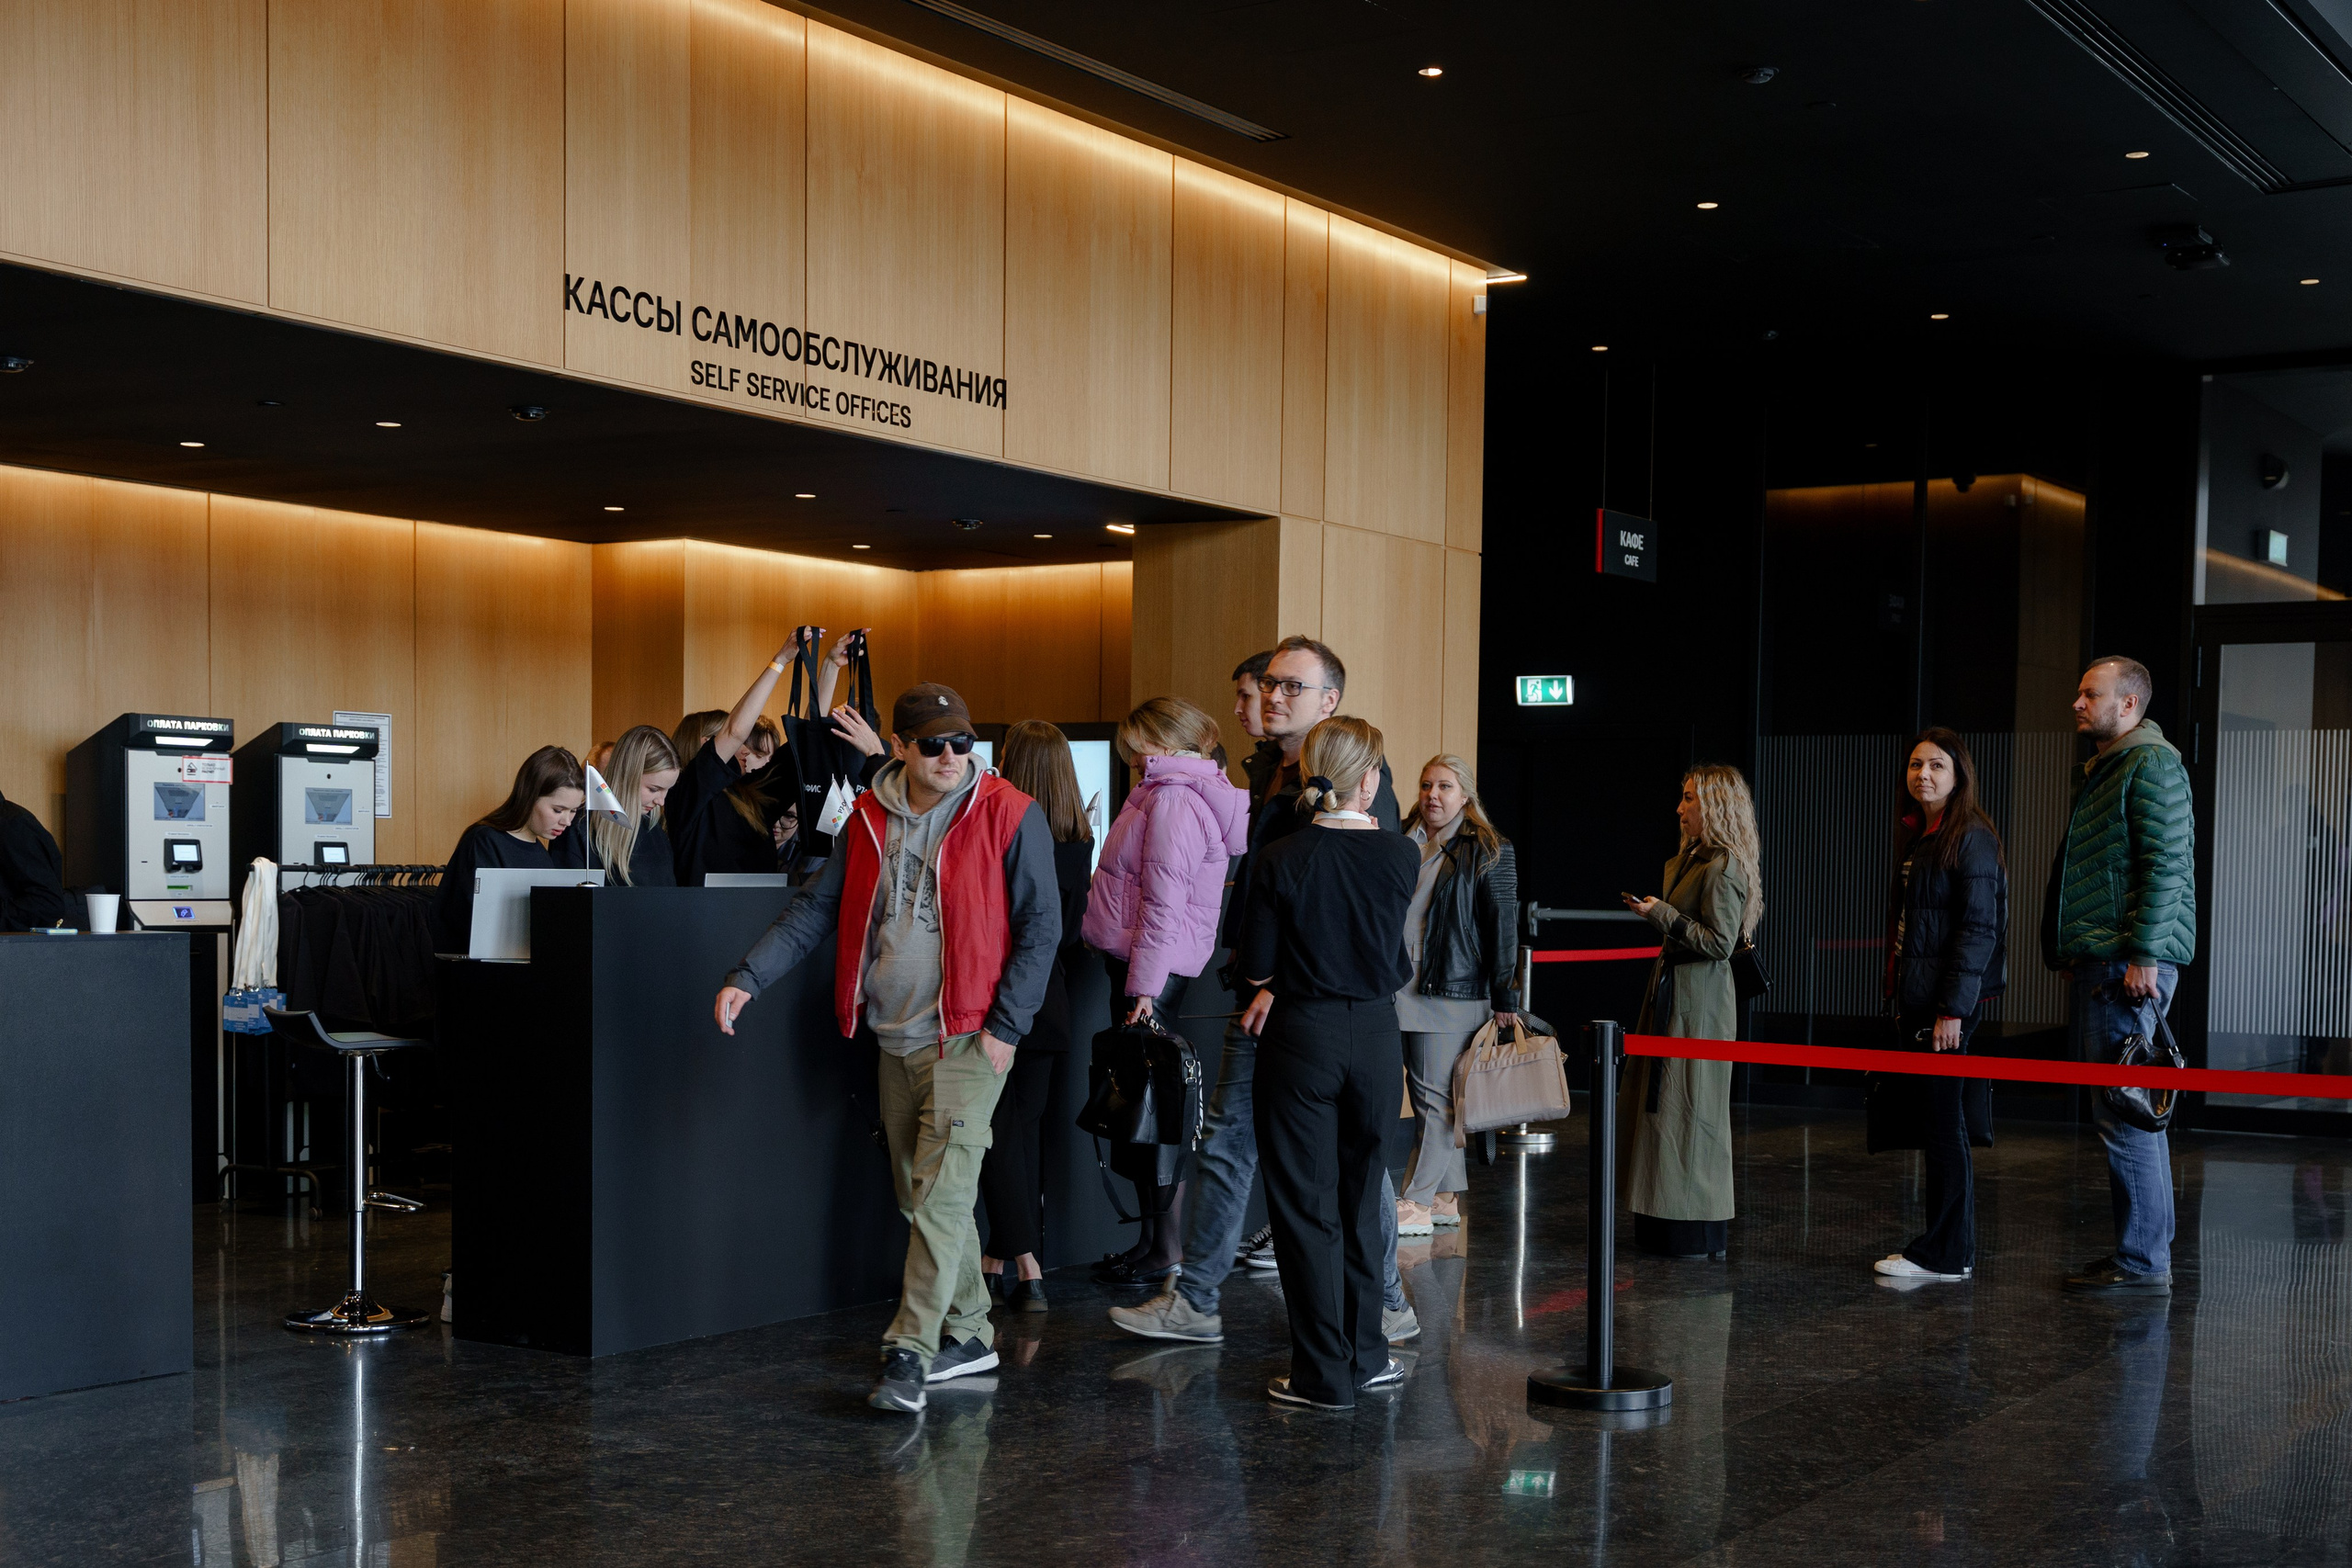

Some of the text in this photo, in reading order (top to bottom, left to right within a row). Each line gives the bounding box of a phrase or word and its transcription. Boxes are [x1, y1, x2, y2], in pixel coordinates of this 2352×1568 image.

[564, 273, 1007, 412] КАССЫ САМООБСЛУЖИВАНИЯ
[691, 360, 911, 429] SELF SERVICE OFFICES
[1620, 530, 1644, 550] КАФЕ
[1624, 554, 1639, 567] CAFE
[147, 719, 230, 732] ОПЛАТА ПАРКОВКИ
[299, 728, 375, 739] ОПЛАТА ПАРКОВКИ
